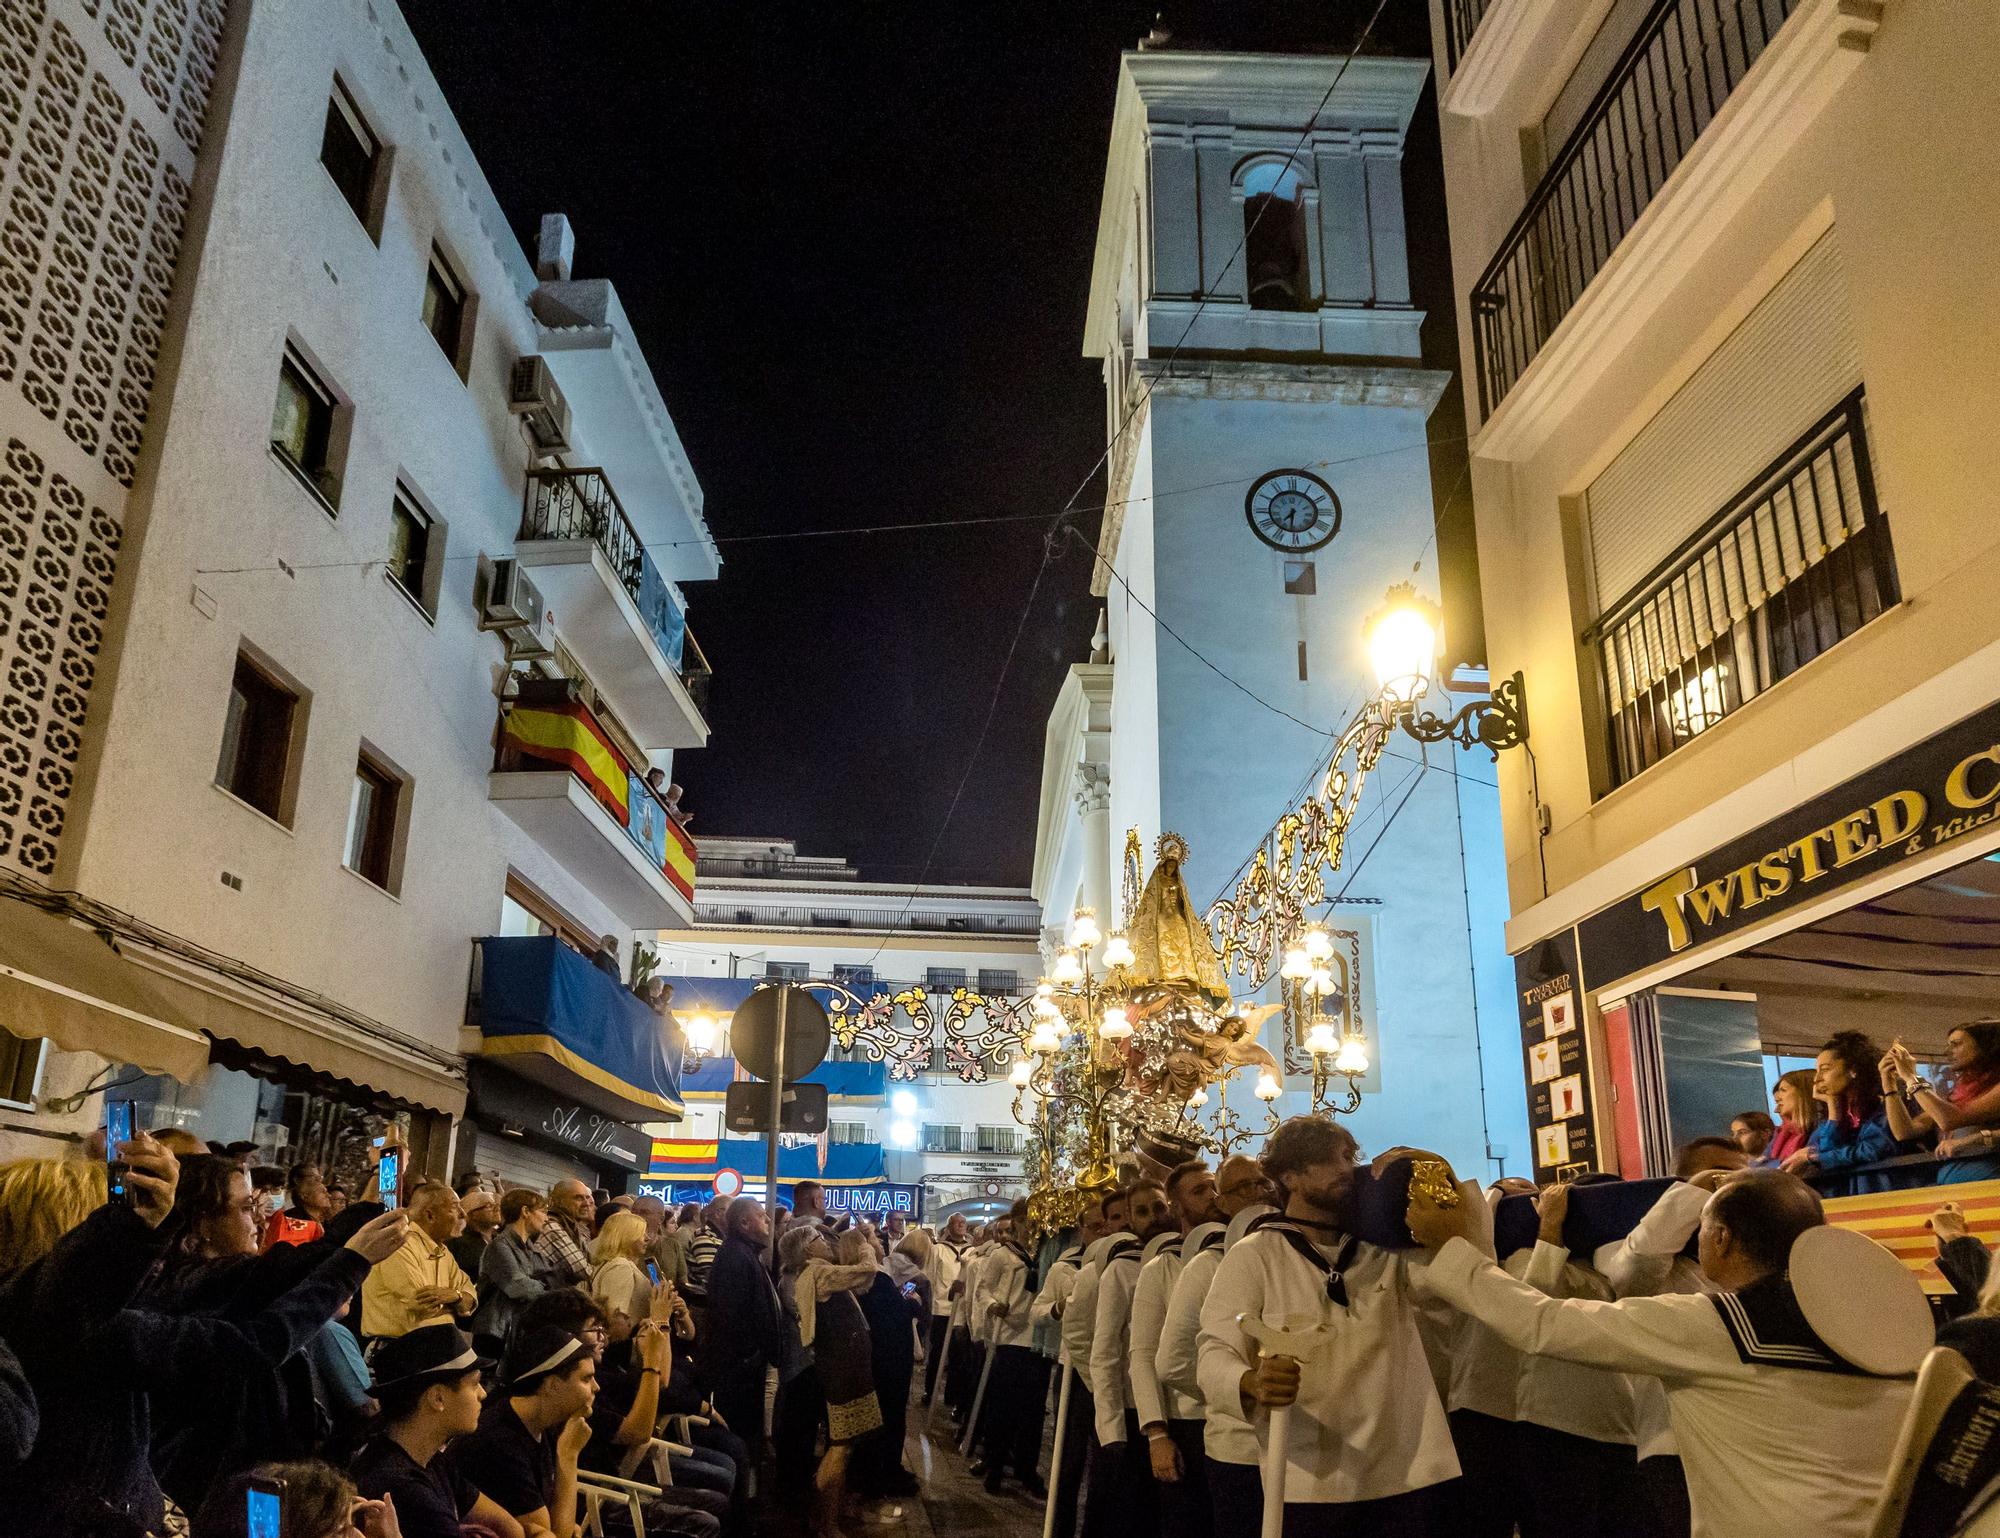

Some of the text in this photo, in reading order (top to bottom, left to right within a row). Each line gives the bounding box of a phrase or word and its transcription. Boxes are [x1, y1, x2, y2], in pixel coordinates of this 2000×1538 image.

[1904, 835, 1925, 856] &
[1641, 790, 1928, 951] TWISTED
[1523, 973, 1570, 1006] TWISTED
[542, 1107, 580, 1142] Arte
